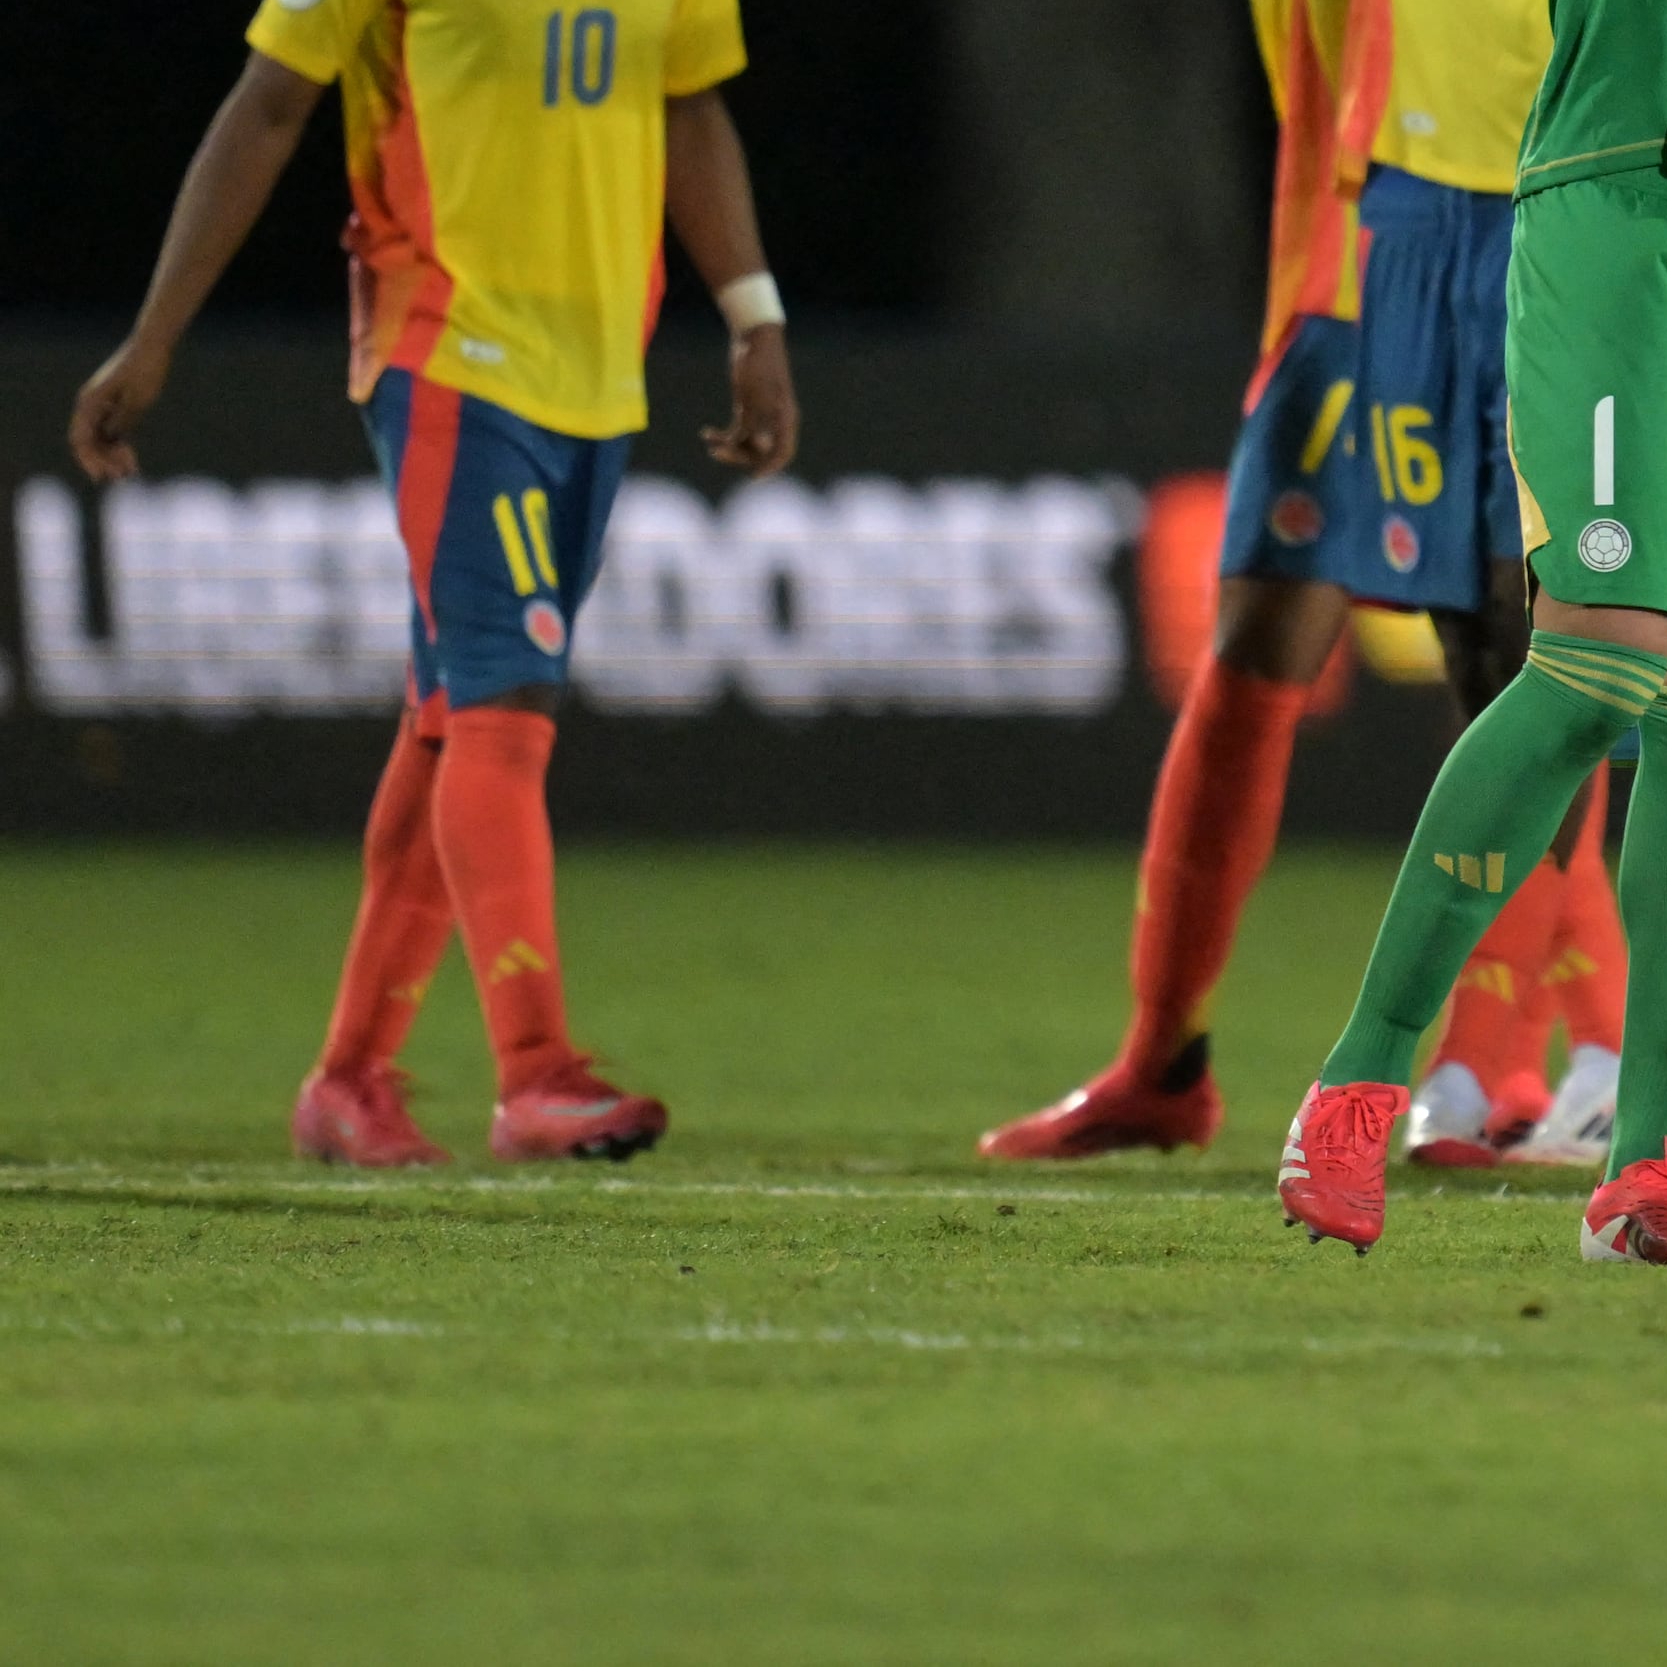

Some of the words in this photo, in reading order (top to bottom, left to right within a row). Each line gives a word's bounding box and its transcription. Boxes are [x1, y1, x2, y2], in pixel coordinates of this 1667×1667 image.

[543, 9, 617, 105] 10
[1370, 402, 1444, 506] 16
[1593, 395, 1615, 506] 1
